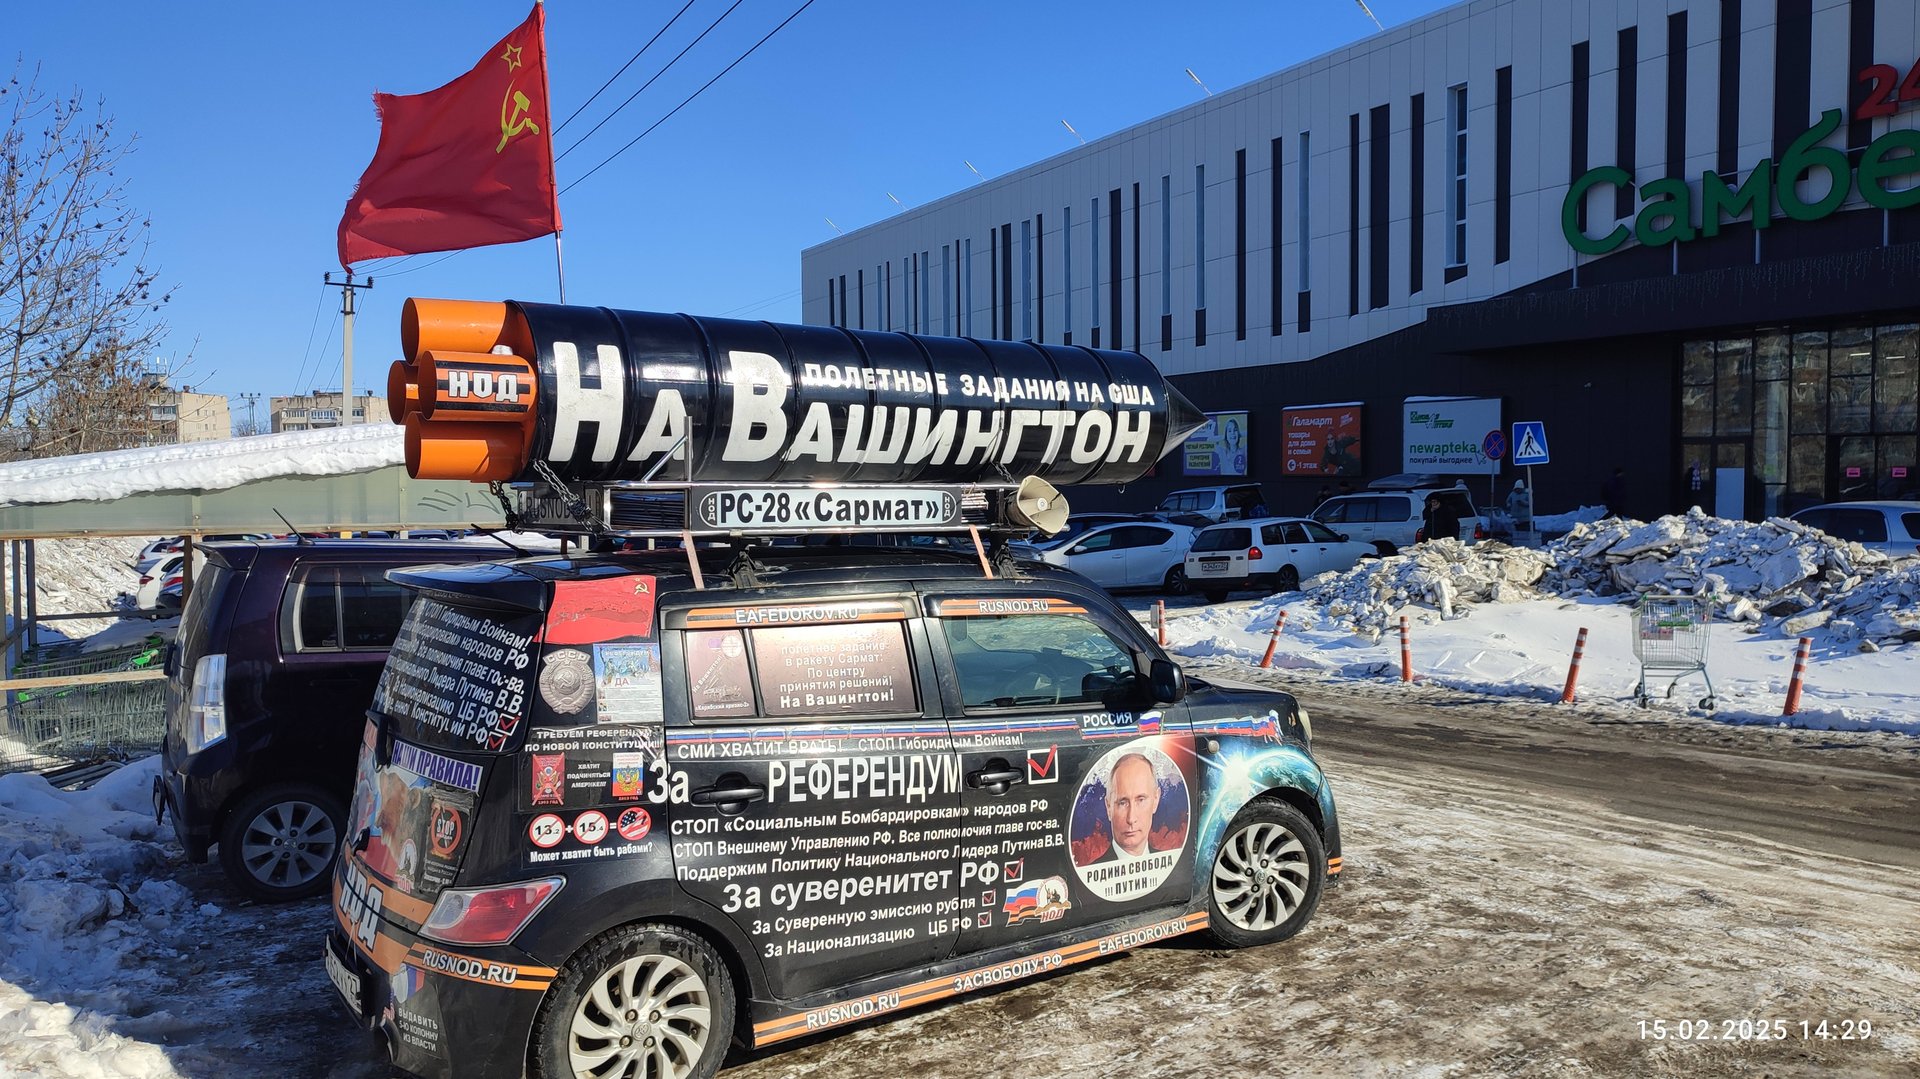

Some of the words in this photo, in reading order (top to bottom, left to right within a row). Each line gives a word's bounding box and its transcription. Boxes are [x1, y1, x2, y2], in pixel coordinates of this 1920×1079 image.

[448, 370, 519, 403] НОД
[803, 362, 948, 396] ПОЛЕТНЫЕ
[960, 374, 1070, 403] ЗАДАНИЯ
[1074, 381, 1105, 403] НА
[1108, 383, 1156, 406] США
[1409, 455, 1438, 465] покупай
[1438, 457, 1473, 465] выгоднее
[708, 498, 716, 521] НОД
[735, 606, 859, 625] EAFEDOROV.RU
[979, 599, 1049, 613] RUSNOD.RU
[479, 618, 533, 652] Войнам!
[460, 637, 504, 662] народов
[504, 648, 529, 670] РФ
[547, 650, 588, 664] СССР
[840, 640, 885, 654] задание
[785, 657, 792, 666] в
[796, 656, 834, 669] ракету
[838, 653, 883, 667] Сармат:
[615, 677, 630, 688] ДА
[779, 681, 836, 693] принятия
[839, 676, 893, 692] решений!
[807, 668, 822, 679] По
[826, 666, 865, 680] центру
[428, 666, 456, 693] Лидера
[455, 676, 494, 704] Путина
[494, 689, 523, 716] В.В.
[780, 697, 800, 709] На
[805, 689, 894, 707] Вашингтон!
[457, 700, 477, 722] ЦБ
[476, 706, 499, 727] РФ
[1082, 711, 1133, 728] РОССИЯ
[466, 723, 488, 744] РФ
[537, 730, 584, 740] ТРЕБУЕМ
[525, 744, 540, 752] ПО
[542, 741, 580, 752] НОВОЙ
[678, 742, 715, 760] СМИ
[720, 741, 783, 759] ХВАТИТ
[858, 737, 895, 751] СТОП
[898, 735, 971, 752] Гибридным
[974, 732, 1024, 748] Войнам!
[416, 751, 481, 791] ПРАВИЛА!
[566, 772, 611, 780] ПОДЧИНЯТЬСЯ
[647, 759, 689, 804] За
[768, 754, 963, 803] РЕФЕРЕНДУМ
[437, 818, 455, 836] STOP
[671, 818, 719, 836] СТОП
[724, 814, 837, 834] «Социальным
[841, 808, 969, 826] Бомбардировкам»
[974, 803, 1027, 818] народов
[1030, 799, 1048, 813] РФ
[673, 841, 713, 859] СТОП
[717, 838, 788, 857] Внешнему
[791, 833, 870, 854] Управлению
[872, 830, 895, 847] РФ.
[898, 829, 920, 843] Все
[923, 824, 992, 842] полномочия
[994, 821, 1024, 835] главе
[1026, 818, 1060, 832] гос-ва.
[530, 850, 560, 863] Может
[562, 849, 591, 862] хватит
[593, 845, 615, 858] быть
[617, 841, 653, 857] рабами?
[677, 861, 767, 883] Поддержим
[771, 854, 842, 874] Политику
[845, 846, 950, 868] Национального
[951, 843, 998, 860] Лидера
[1087, 864, 1126, 884] РОДИНА
[1128, 855, 1173, 875] СВОБОДА
[722, 882, 761, 913] За
[770, 869, 953, 911] суверенитет
[960, 860, 999, 888] РФ
[1115, 877, 1148, 895] ПУТИН
[339, 863, 383, 950] НОД
[752, 919, 771, 935] За
[775, 909, 866, 935] Суверенную
[870, 900, 932, 921] эмиссию
[936, 898, 975, 917] рубля
[764, 943, 782, 958] За
[787, 926, 915, 956] Национализацию
[928, 919, 948, 937] ЦБ
[951, 918, 972, 932] РФ
[1098, 919, 1188, 954] EAFEDOROV.RU
[422, 950, 518, 984] RUSNOD.RU
[953, 953, 1063, 993] ЗАСВОБОДУ.РФ
[398, 1007, 438, 1030] ВЫДАВИТЬ
[806, 992, 900, 1030] RUSNOD.RU
[403, 1032, 411, 1043] ИЗ
[412, 1035, 437, 1052] ВЛАСТИ
[410, 1024, 439, 1041] КОЛОННУ
